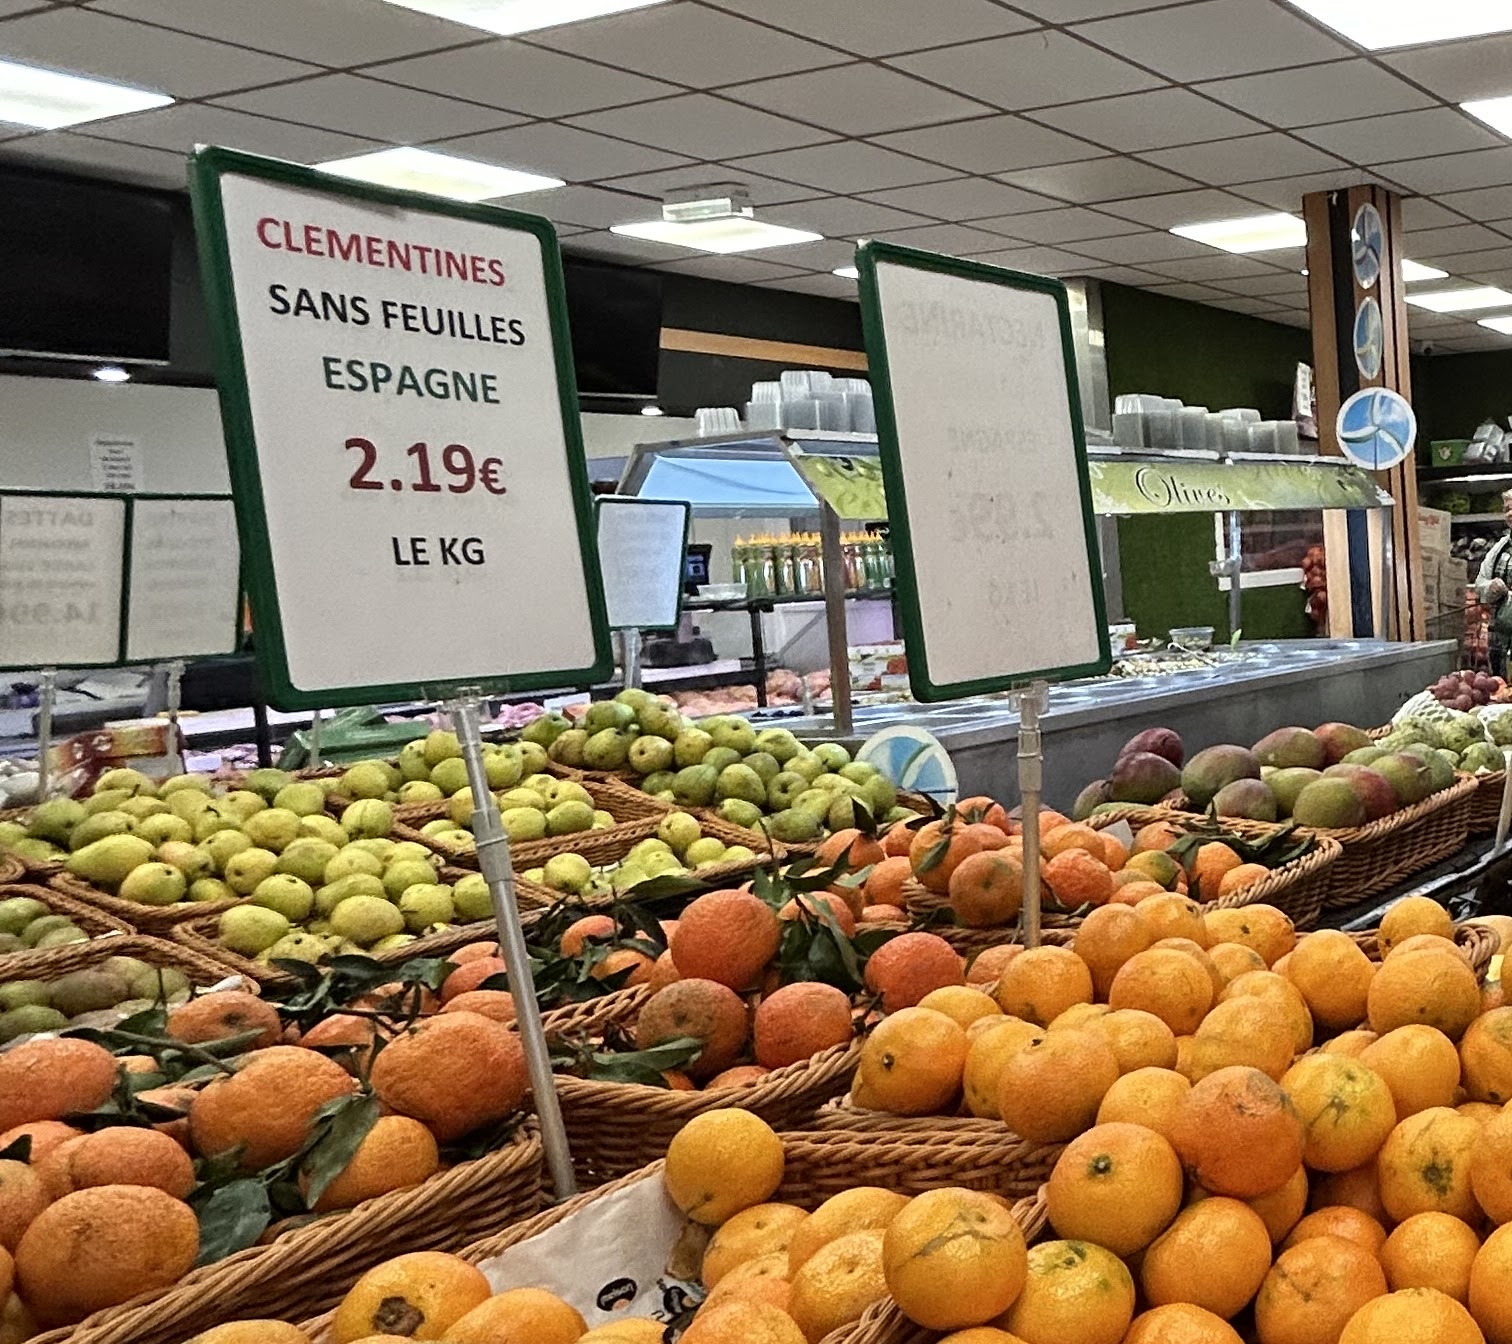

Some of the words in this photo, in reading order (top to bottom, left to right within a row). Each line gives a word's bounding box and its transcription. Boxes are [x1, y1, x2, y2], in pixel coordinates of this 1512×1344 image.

[256, 216, 506, 287] CLEMENTINES
[268, 283, 371, 326] SANS
[380, 299, 526, 347] FEUILLES
[322, 355, 501, 405] ESPAGNE
[344, 437, 507, 495] 2.19€
[1135, 465, 1231, 509] Olives
[391, 536, 430, 566] LE
[439, 536, 486, 566] KG
